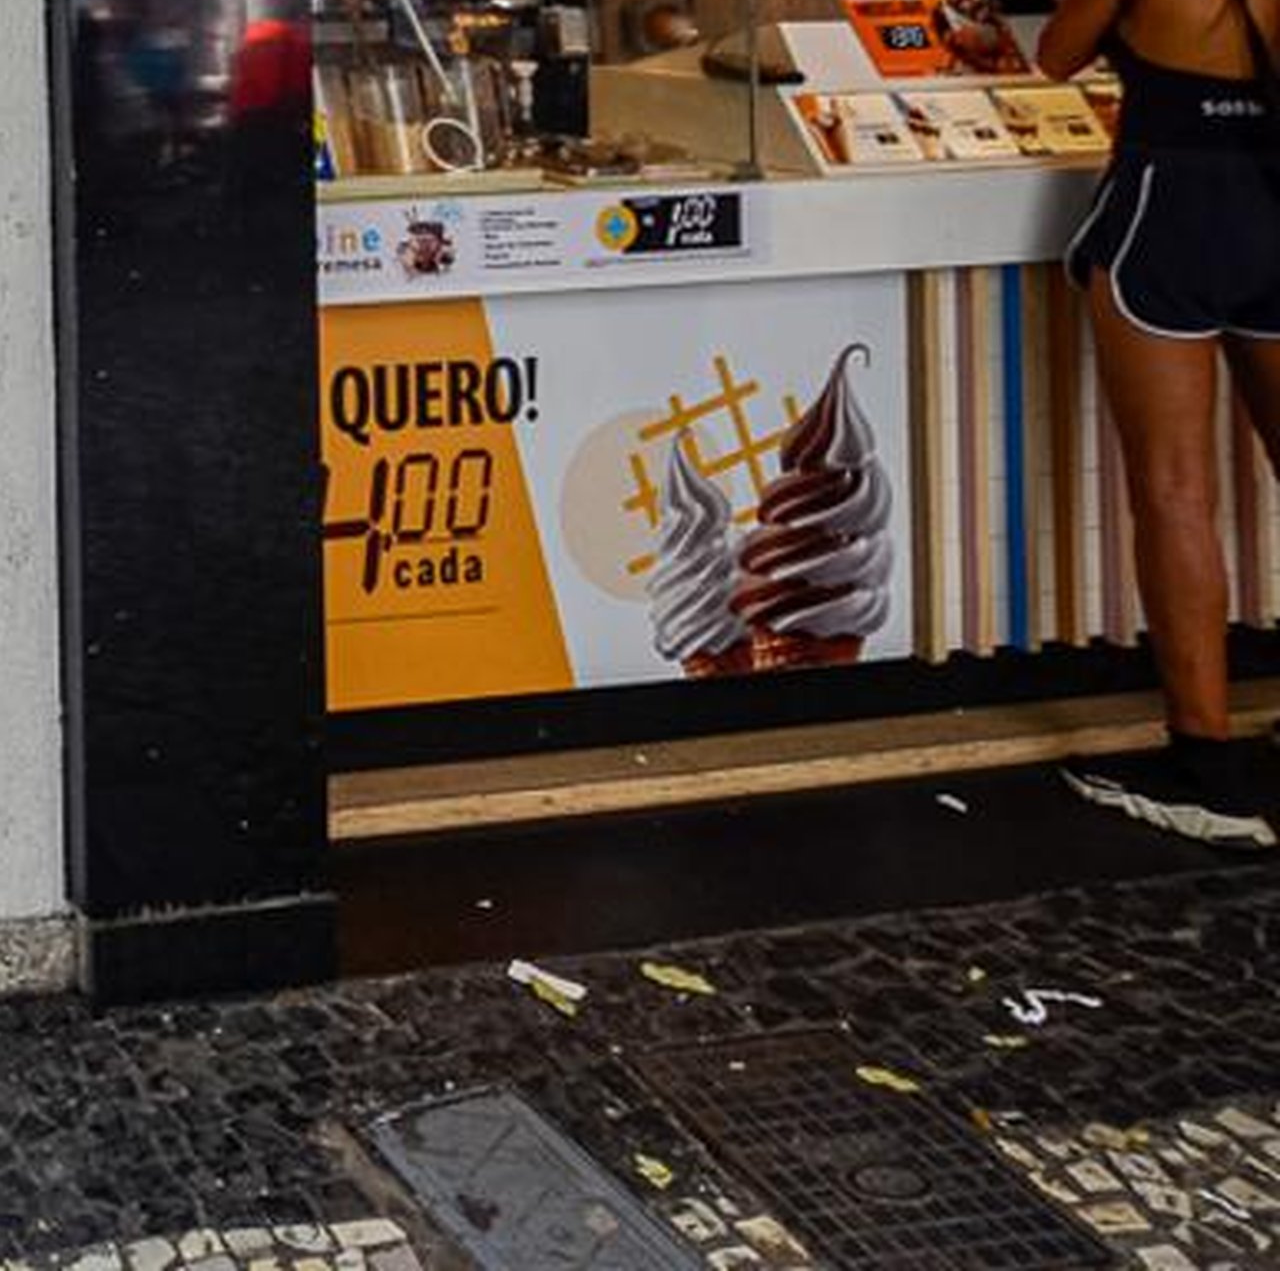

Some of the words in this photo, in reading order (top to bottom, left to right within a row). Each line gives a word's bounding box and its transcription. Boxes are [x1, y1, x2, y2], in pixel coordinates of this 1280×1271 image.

[317, 224, 381, 254] ine
[329, 355, 540, 446] QUERO!
[393, 546, 483, 589] cada
